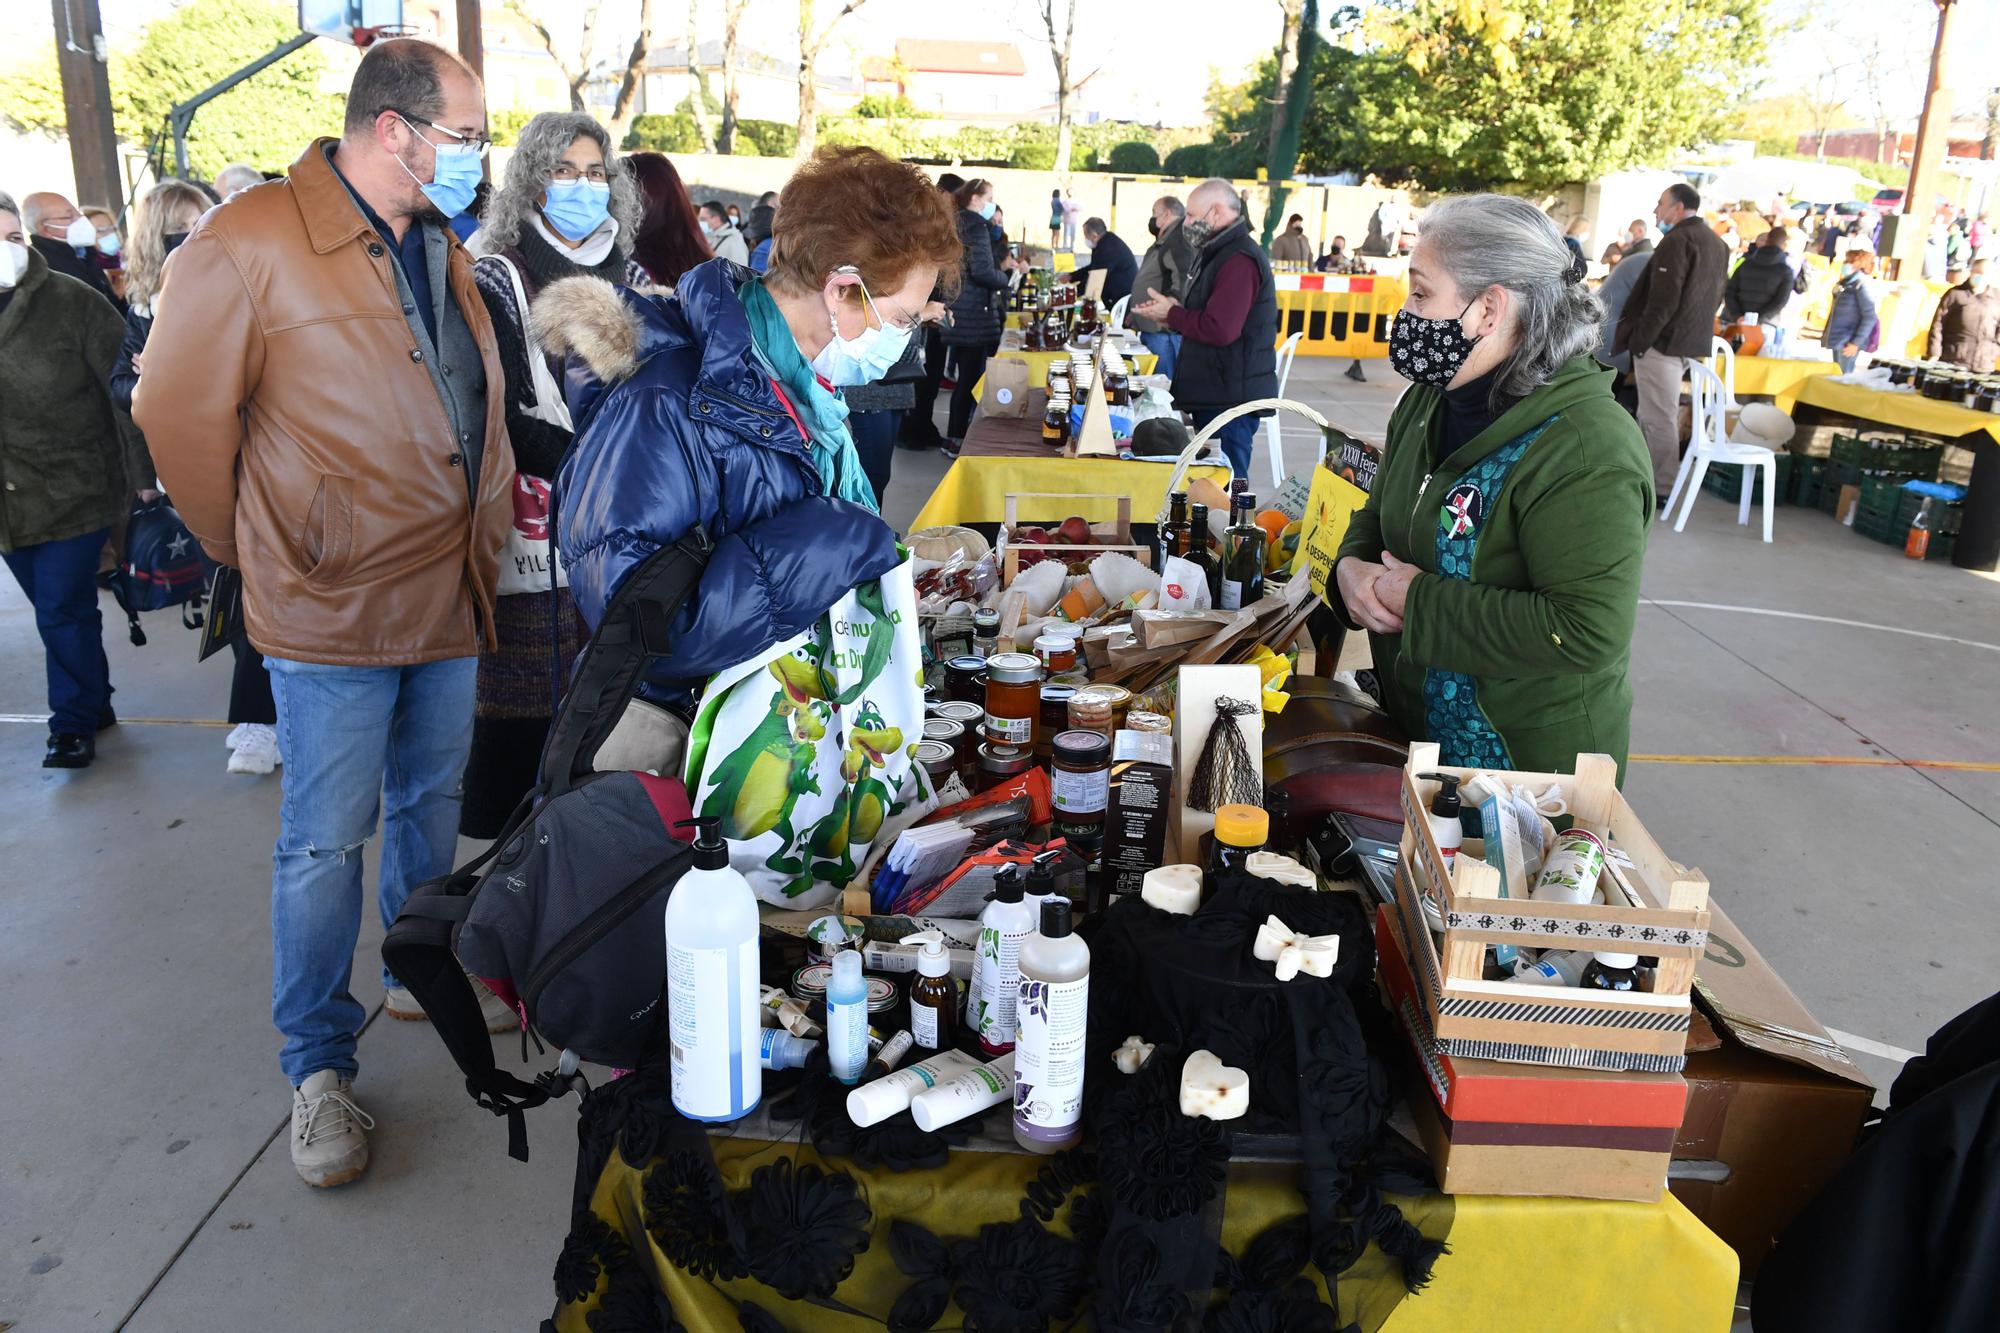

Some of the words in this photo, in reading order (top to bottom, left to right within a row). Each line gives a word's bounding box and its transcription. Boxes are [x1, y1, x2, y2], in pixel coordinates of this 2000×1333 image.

[1360, 452, 1378, 475] Feira
[834, 615, 849, 636] de
[851, 608, 902, 638] nua
